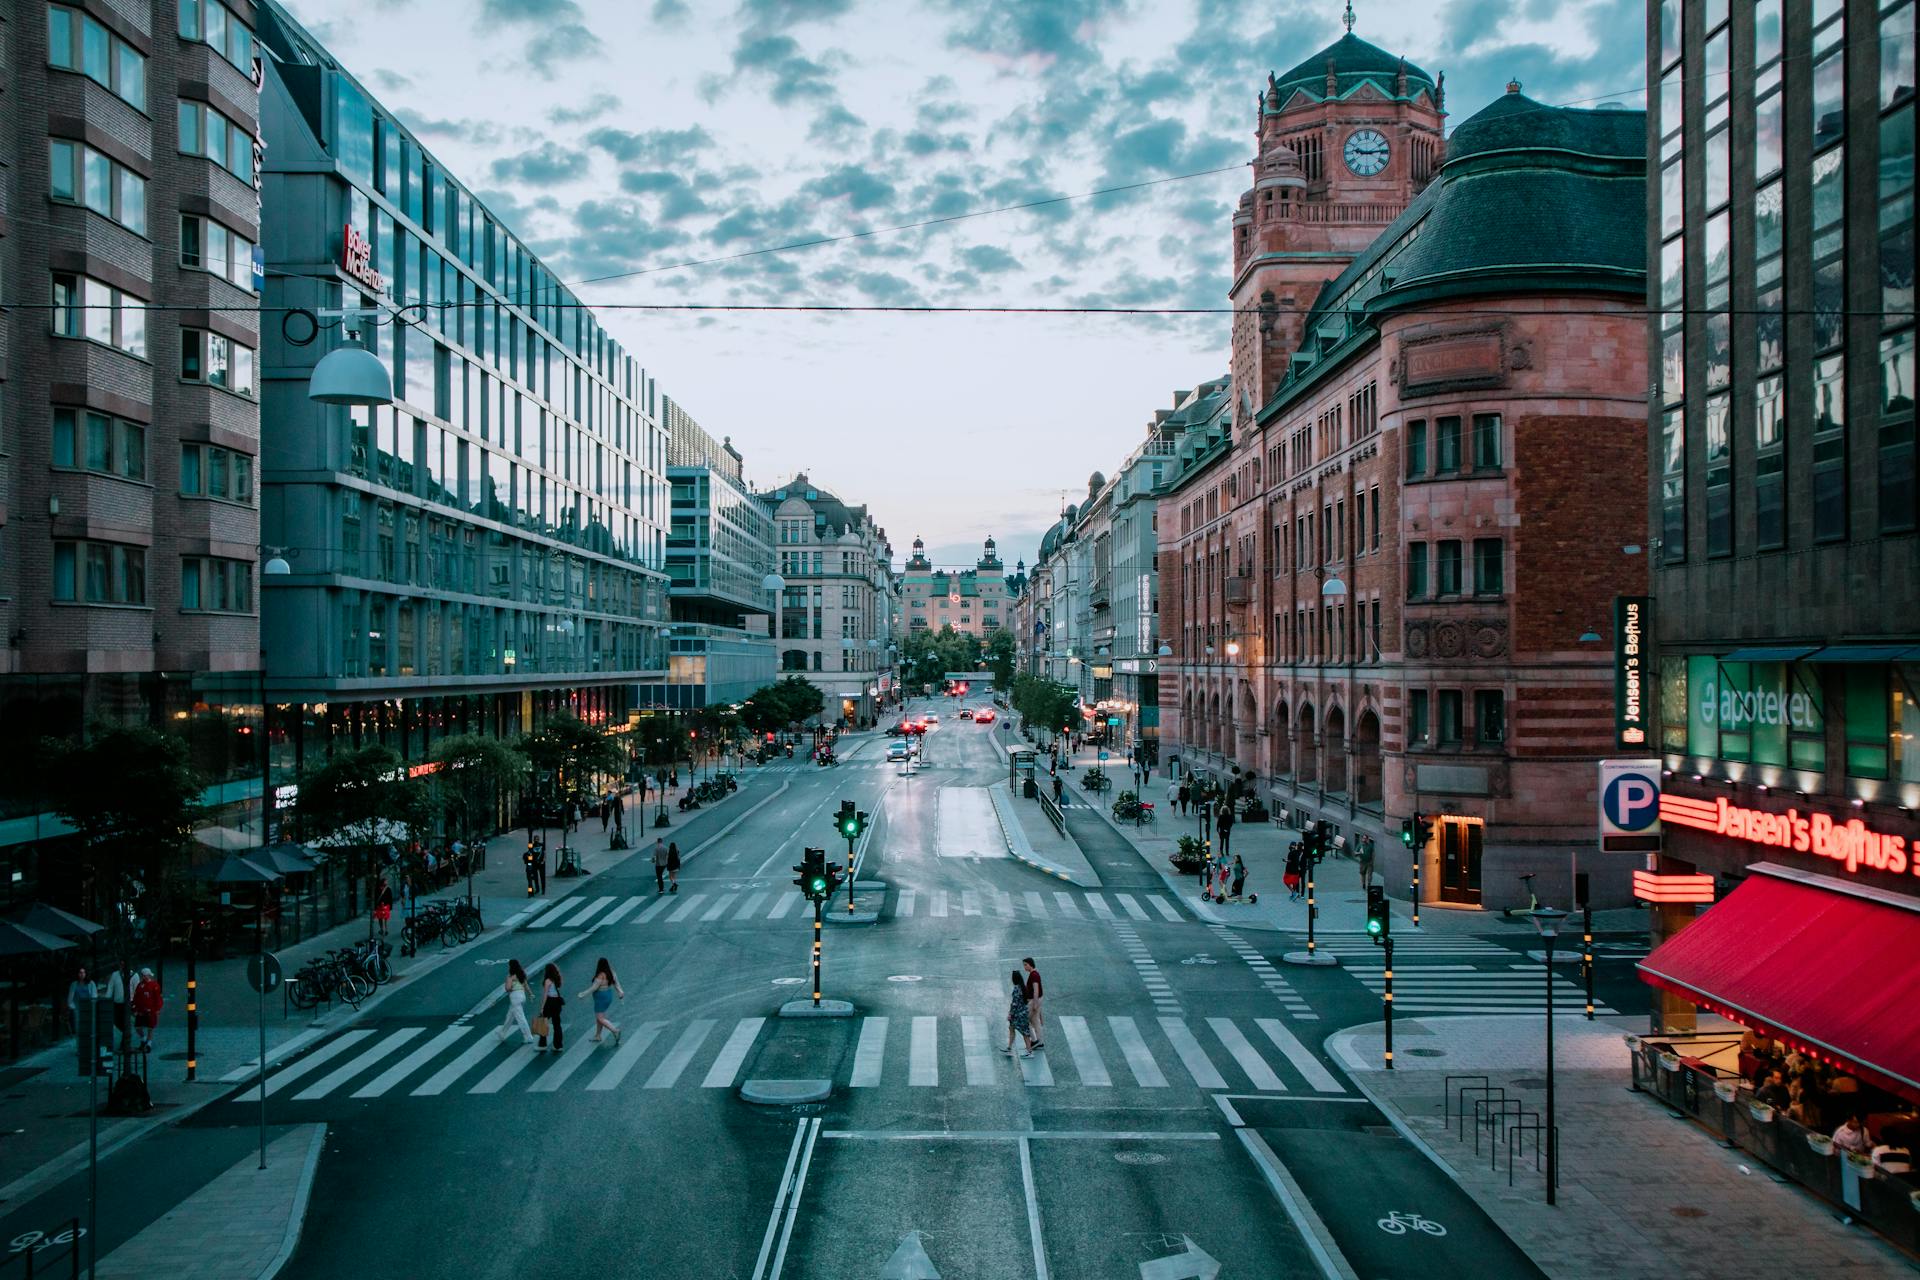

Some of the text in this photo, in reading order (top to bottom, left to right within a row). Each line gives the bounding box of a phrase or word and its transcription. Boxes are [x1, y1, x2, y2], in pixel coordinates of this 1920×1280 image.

[1624, 657, 1640, 722] Jensen's
[1721, 682, 1814, 731] apoteket
[1618, 780, 1654, 825] P
[1716, 797, 1907, 873] Jensen's Bøfhus
